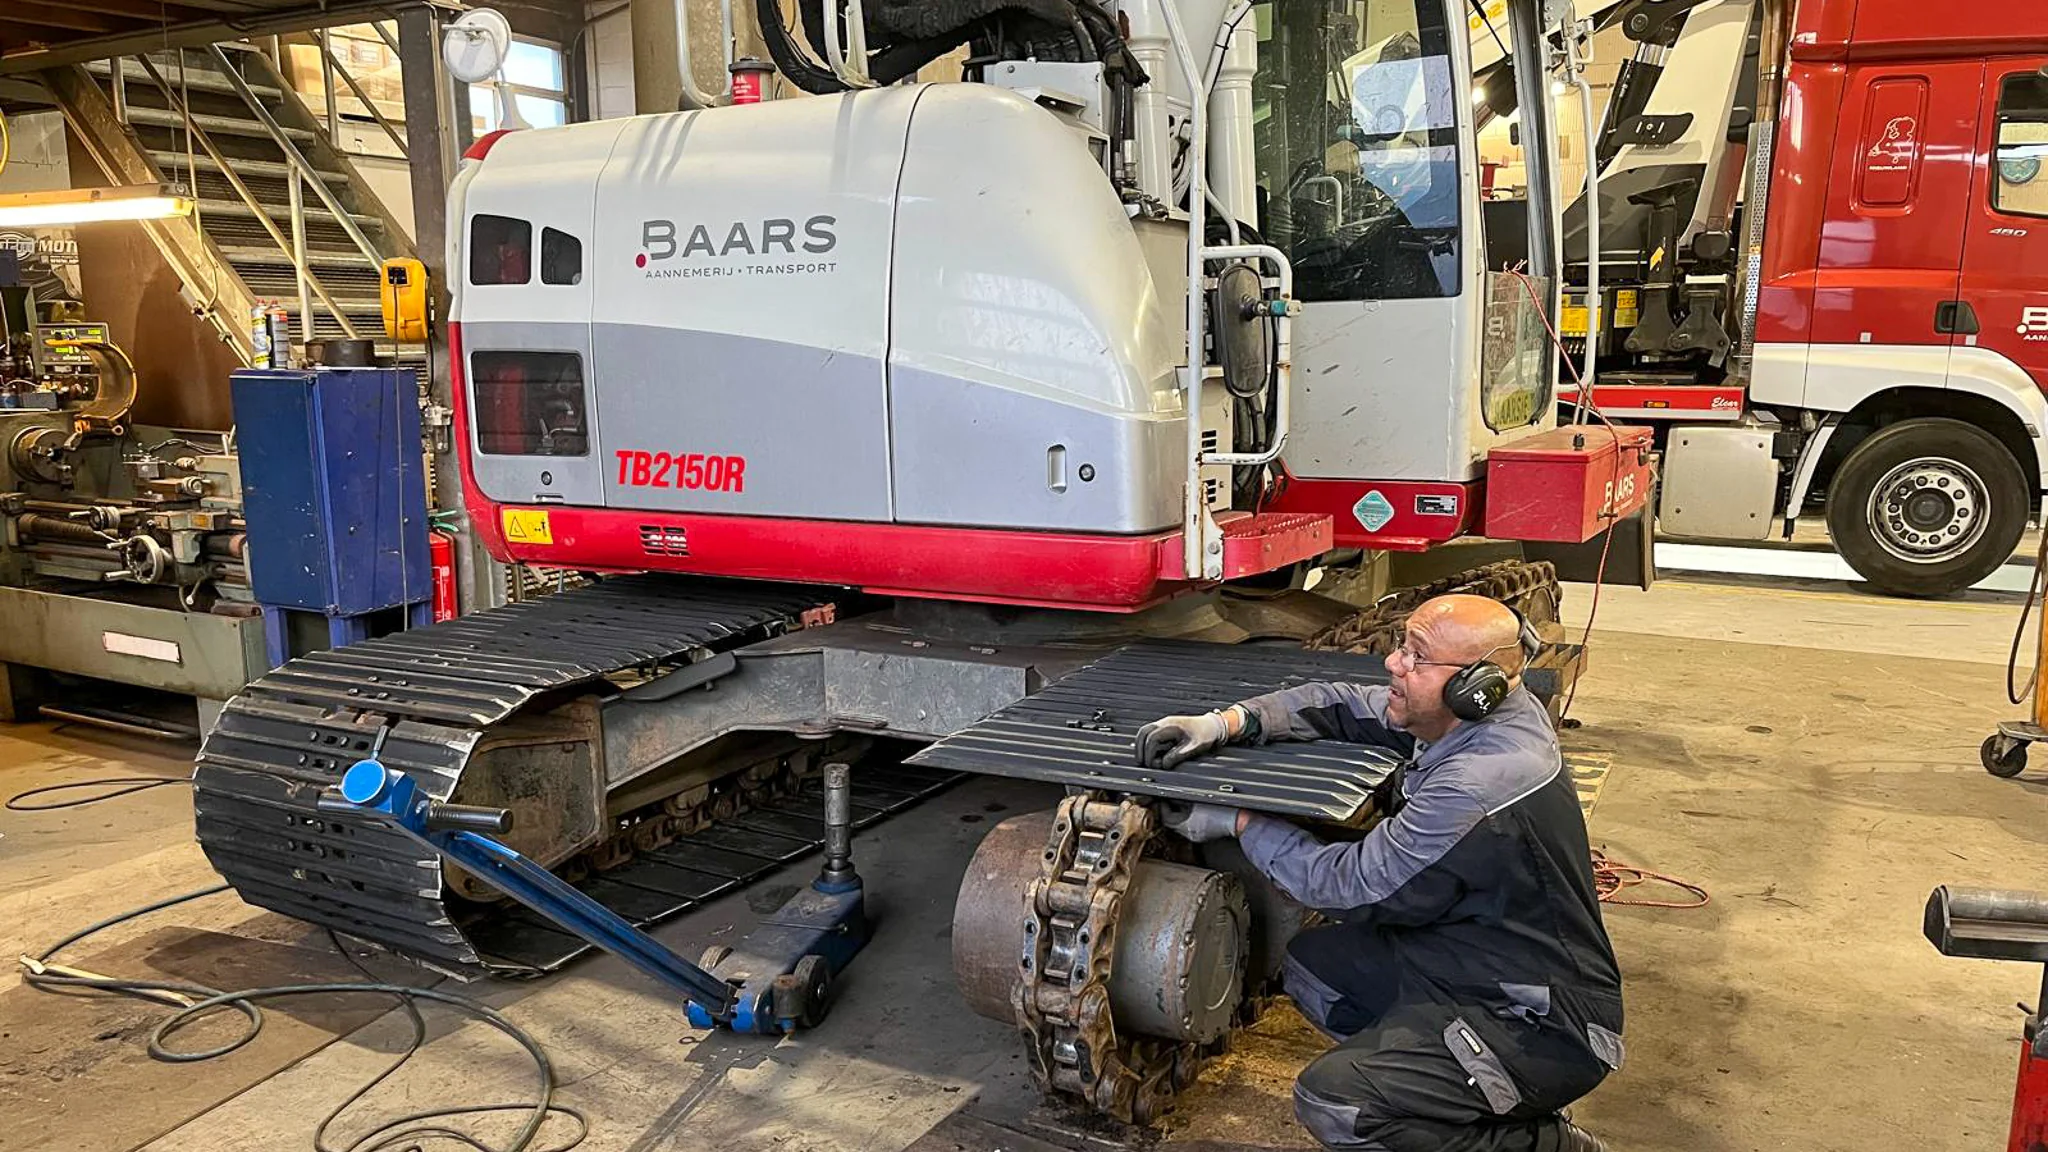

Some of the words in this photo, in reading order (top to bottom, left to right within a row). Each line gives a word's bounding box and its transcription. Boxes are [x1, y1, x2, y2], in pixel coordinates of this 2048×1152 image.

[642, 215, 837, 260] BAARS
[646, 267, 733, 279] AANNEMERIJ
[746, 263, 837, 275] TRANSPORT
[616, 450, 745, 493] TB2150R
